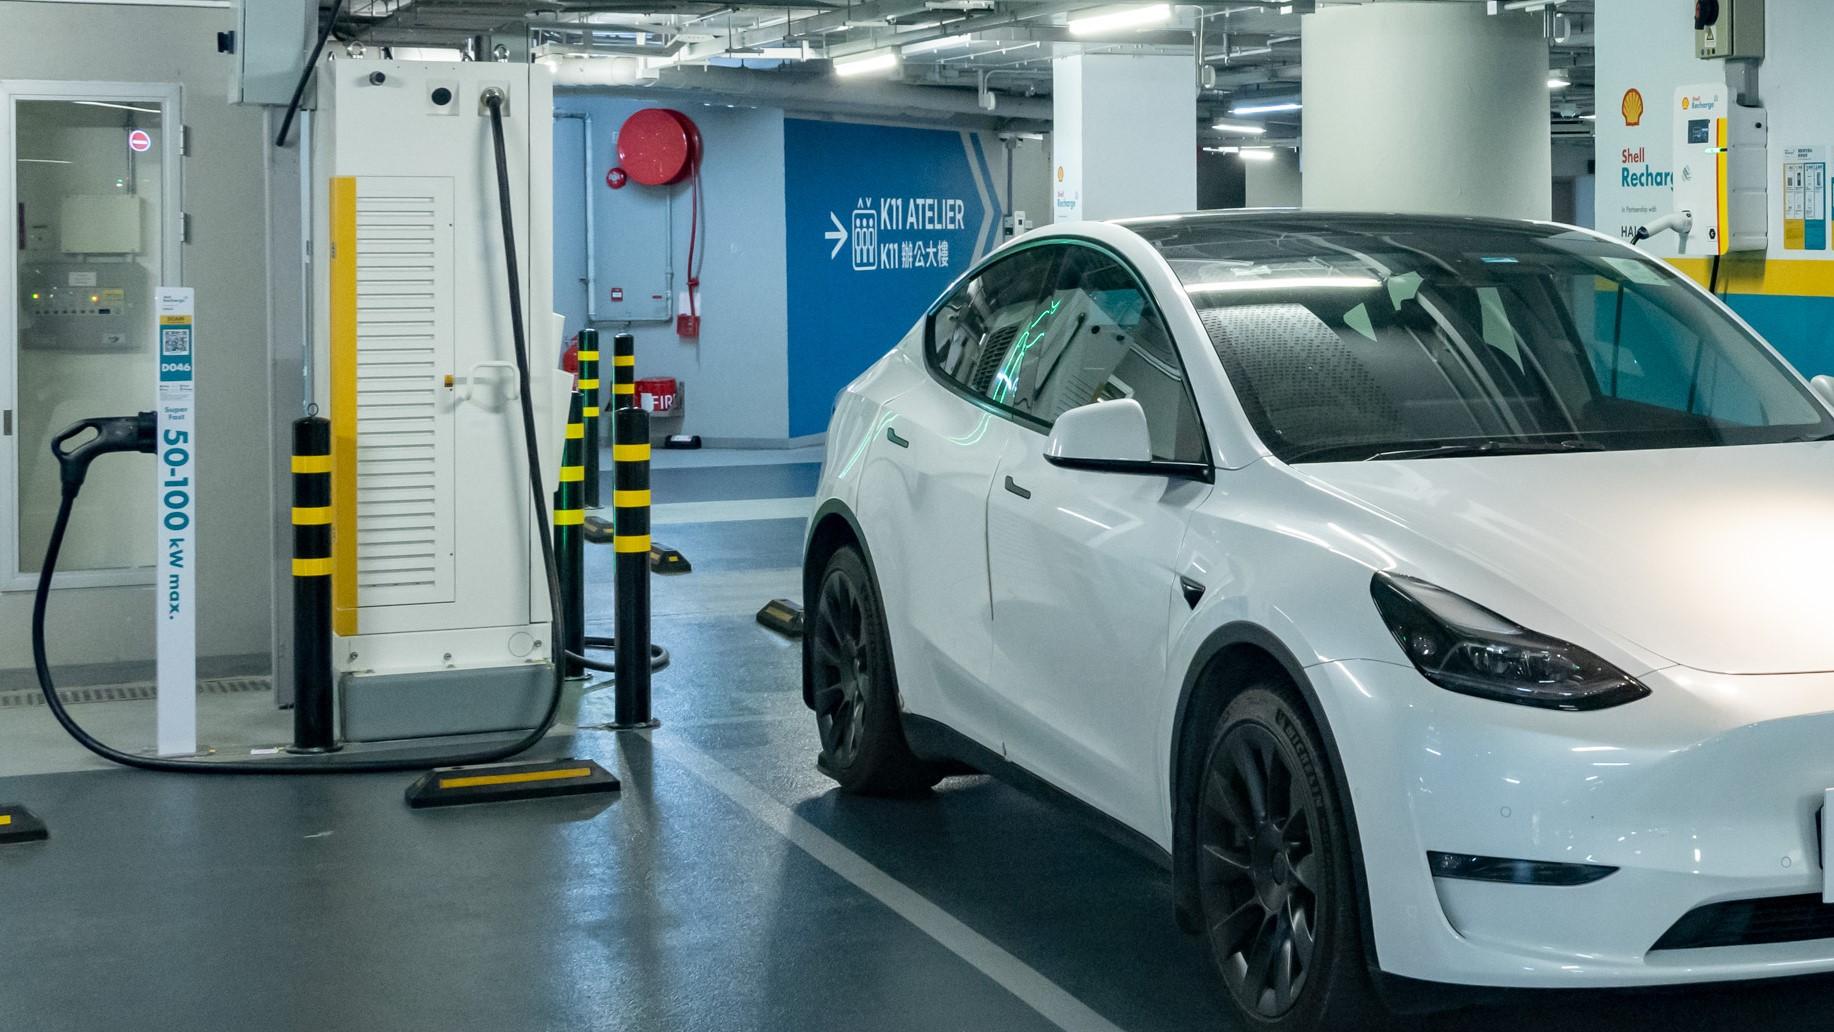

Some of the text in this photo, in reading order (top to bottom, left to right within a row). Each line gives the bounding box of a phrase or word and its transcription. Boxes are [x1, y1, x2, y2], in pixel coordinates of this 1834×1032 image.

[1622, 147, 1645, 163] Shell
[1621, 164, 1673, 192] Rechar
[880, 198, 965, 230] K11 ATELIER
[880, 240, 949, 269] K11 辦公大樓
[161, 363, 191, 372] D046
[164, 406, 188, 414] Super
[652, 393, 676, 410] FIR
[163, 429, 190, 620] 50-100 kW max.
